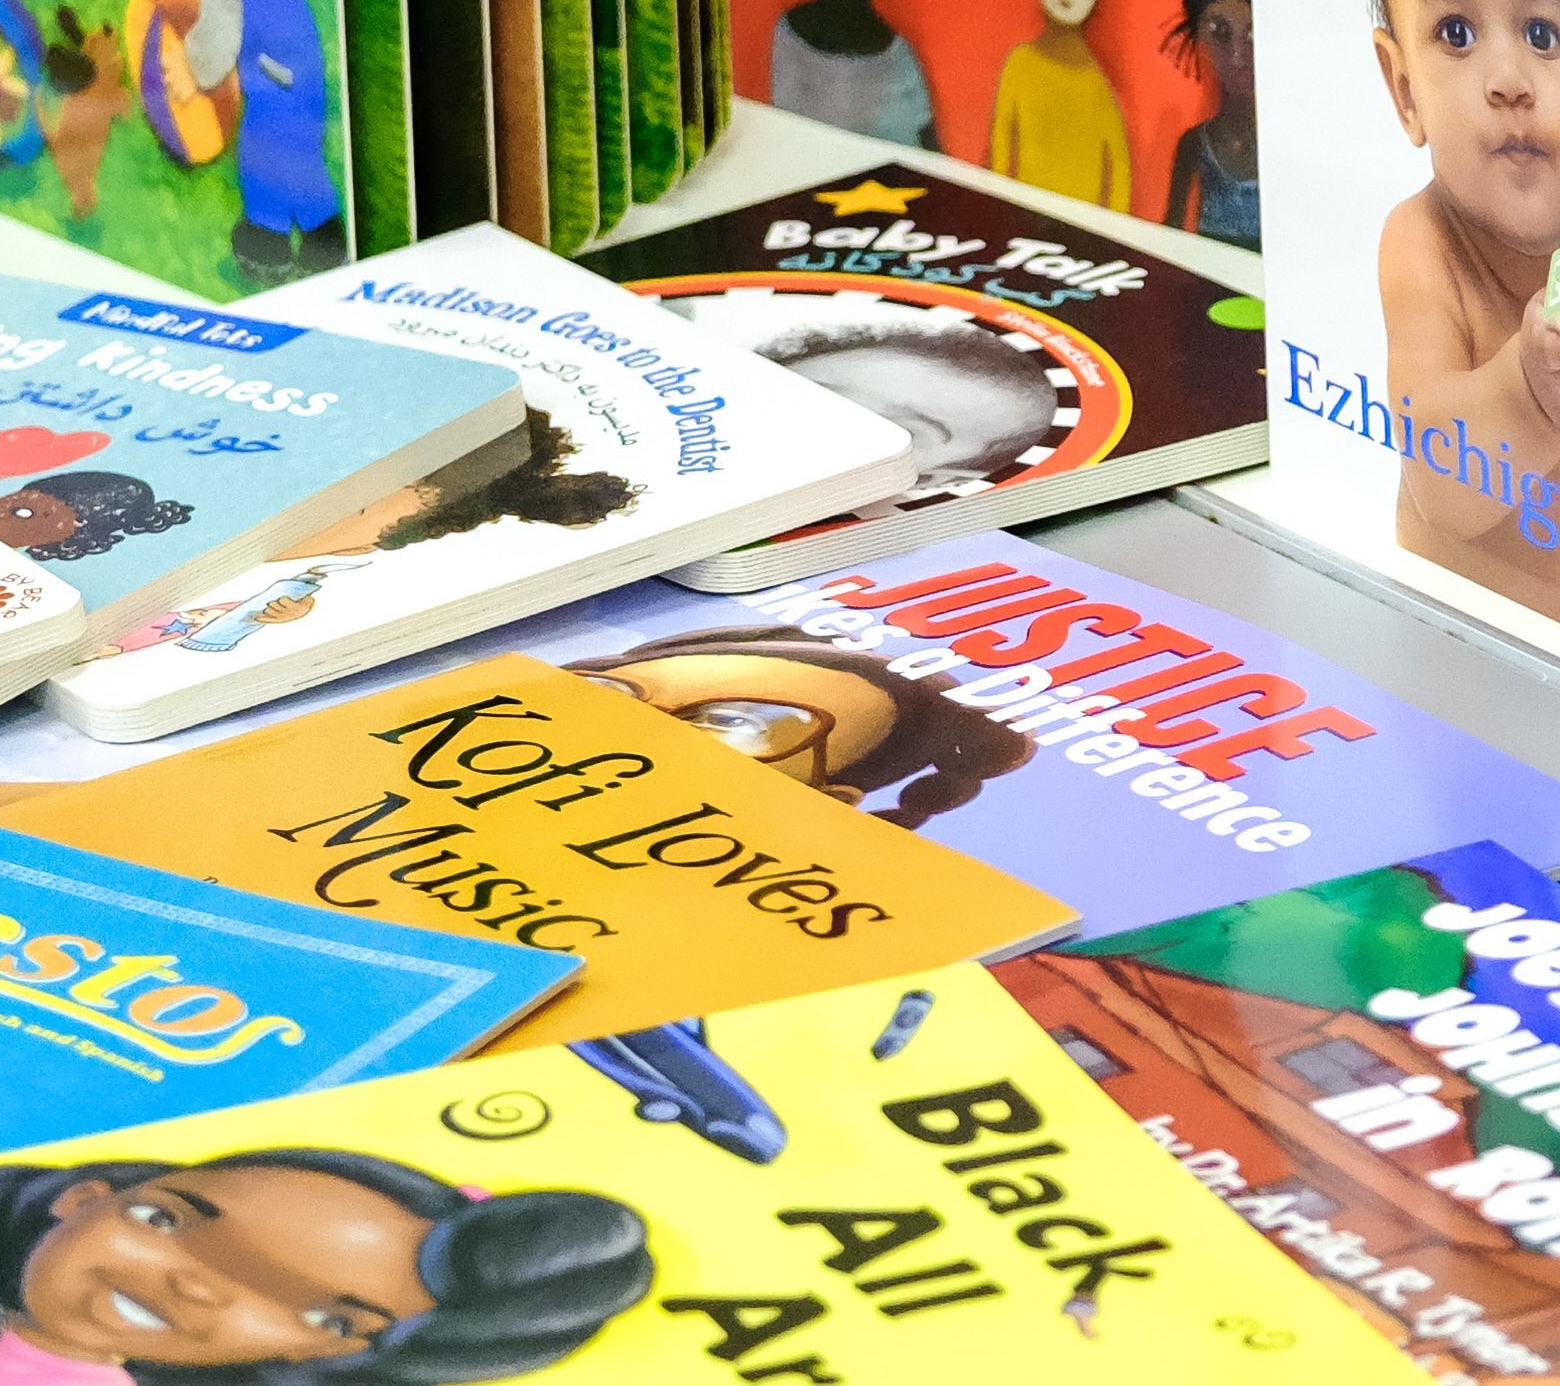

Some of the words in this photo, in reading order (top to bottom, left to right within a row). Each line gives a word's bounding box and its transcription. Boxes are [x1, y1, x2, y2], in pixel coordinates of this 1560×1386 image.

[763, 218, 988, 265] Baby
[996, 237, 1150, 298] Talk
[81, 299, 200, 338] Mindful
[201, 321, 265, 349] Tots
[339, 280, 540, 326] Madison
[539, 311, 634, 354] Goes
[76, 339, 341, 417] Kindness
[616, 344, 663, 371] to
[642, 365, 703, 401] the
[666, 395, 733, 476] Dentist
[820, 562, 1378, 783] JUSTICE
[886, 640, 960, 682] a
[938, 661, 1312, 854] Difference
[368, 693, 656, 813] Kofi
[561, 801, 895, 940] Loves
[266, 790, 622, 952] Music
[24, 1017, 77, 1045] and
[74, 1035, 167, 1084] Spanish
[1308, 1074, 1462, 1156] in
[880, 1076, 1175, 1294] Black
[774, 1204, 1007, 1318] All
[1229, 1192, 1384, 1278] Artika
